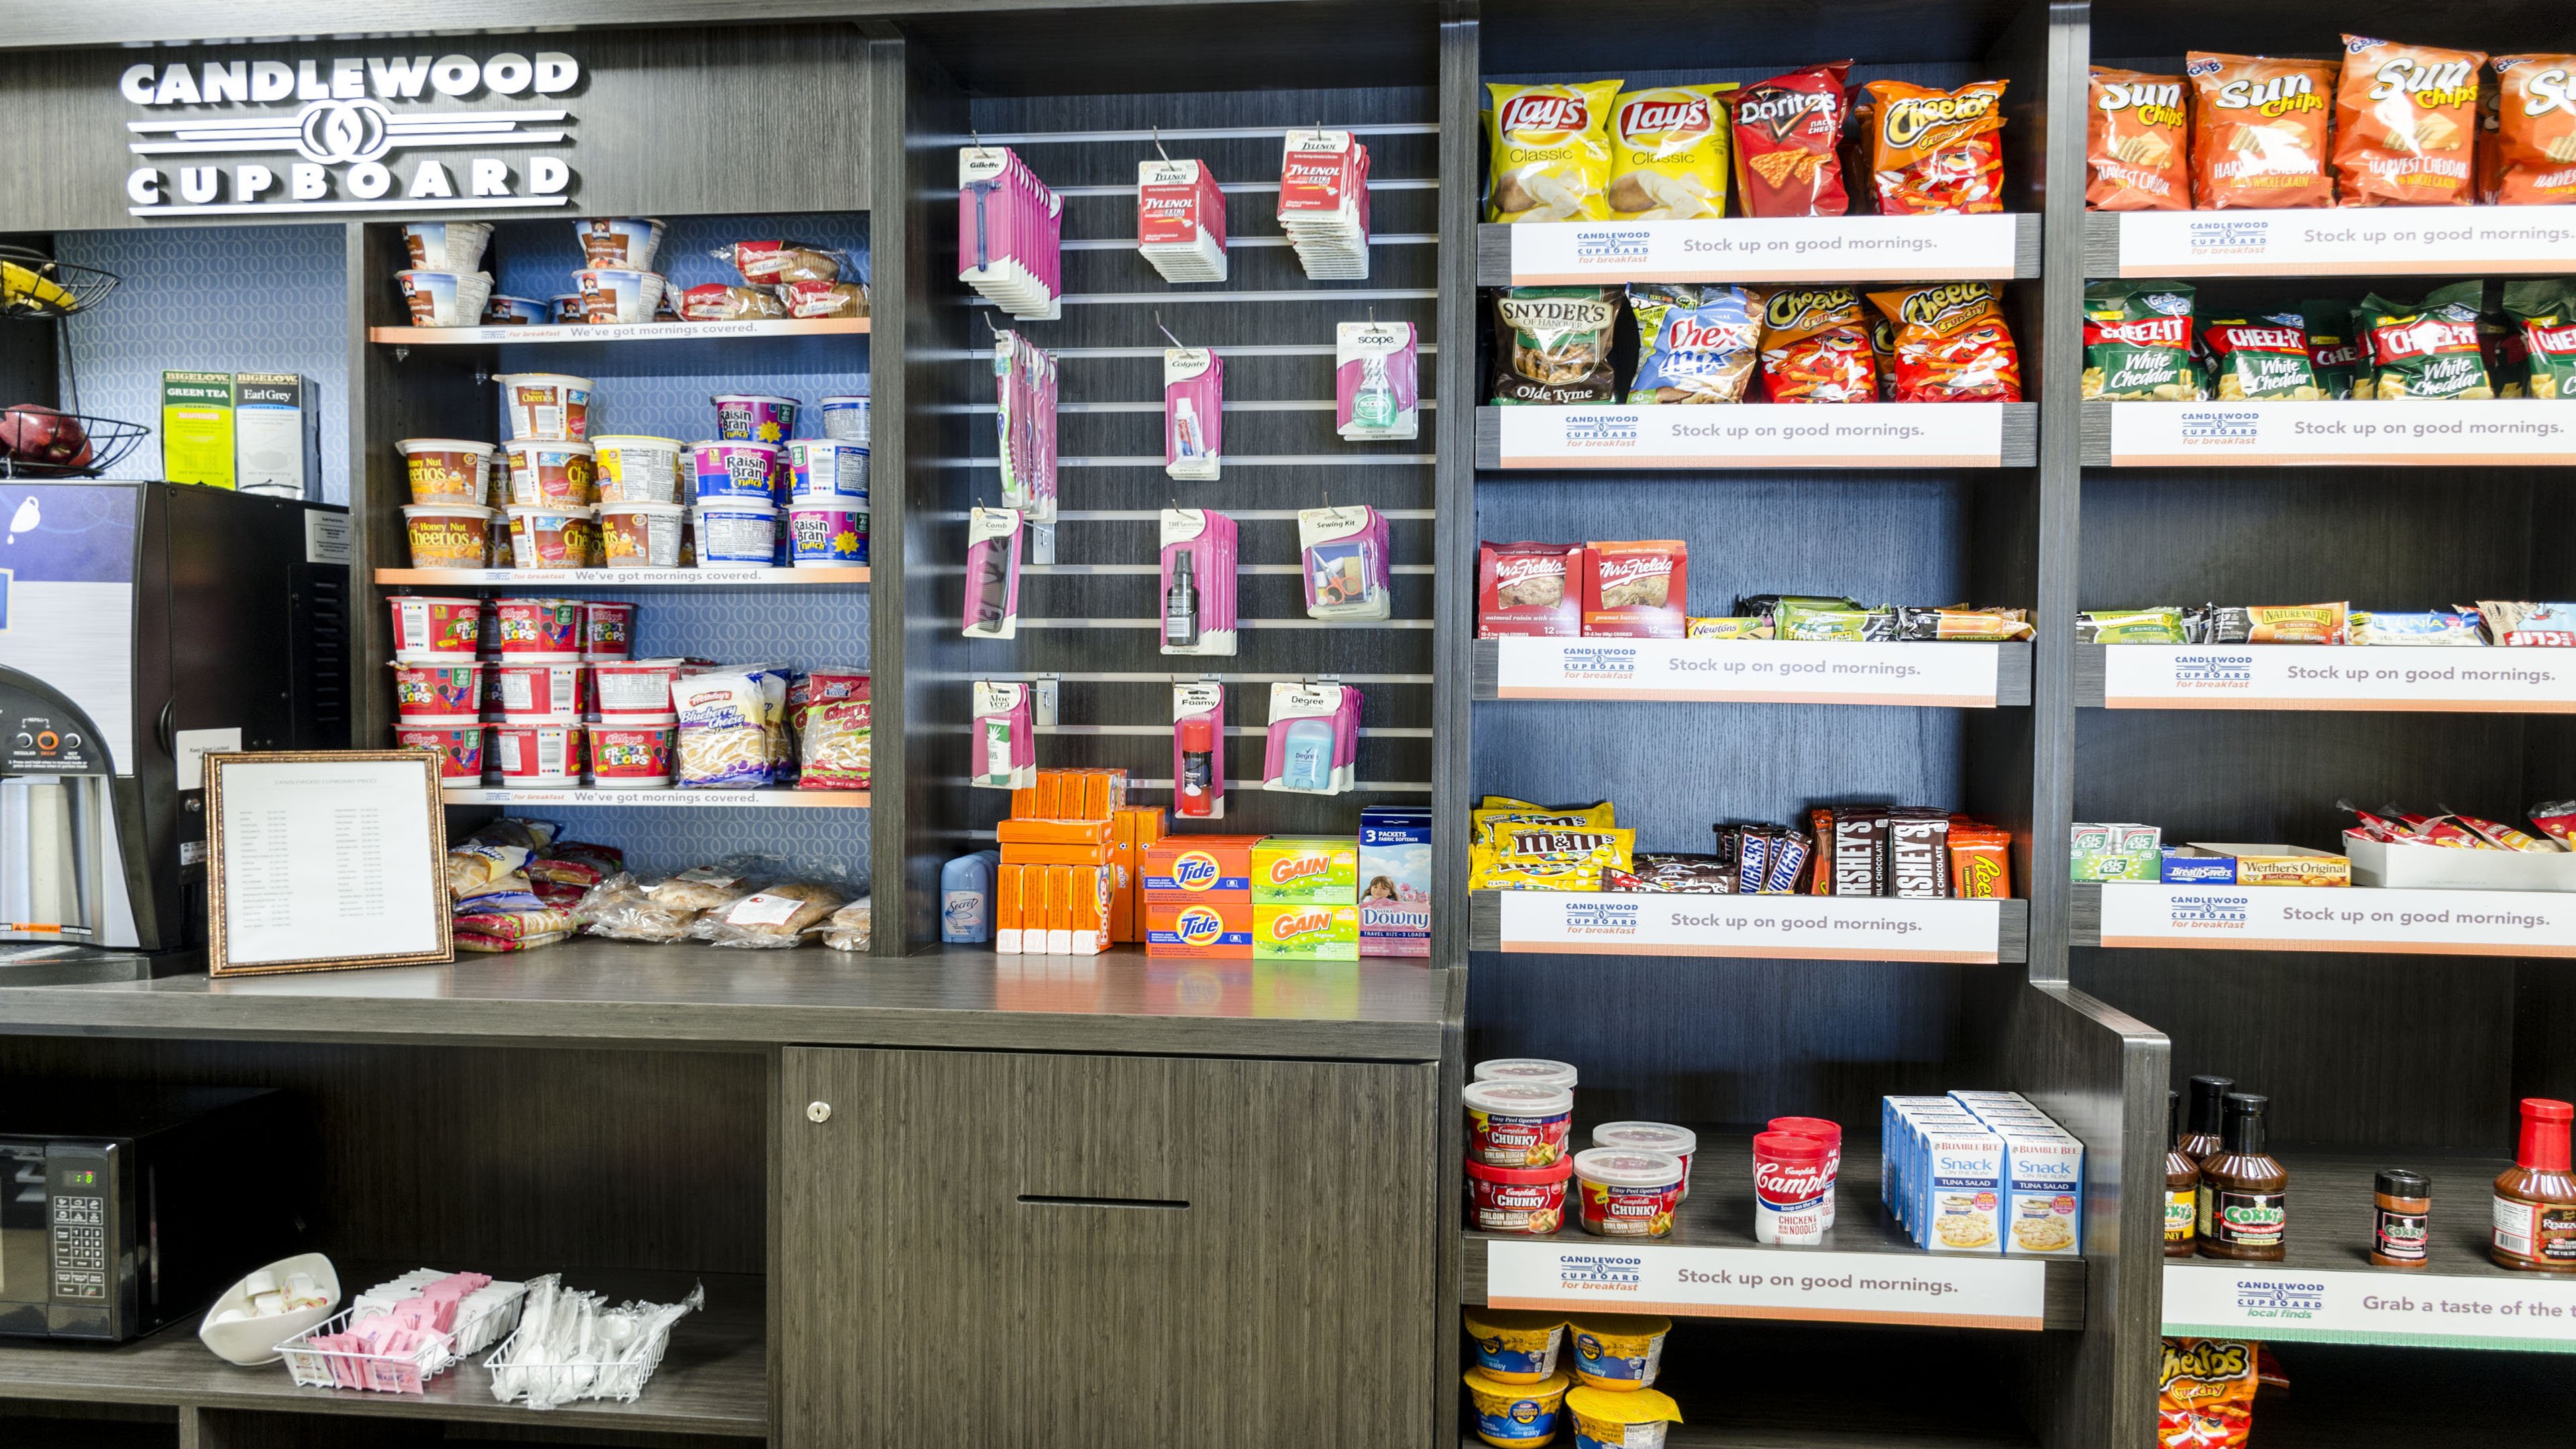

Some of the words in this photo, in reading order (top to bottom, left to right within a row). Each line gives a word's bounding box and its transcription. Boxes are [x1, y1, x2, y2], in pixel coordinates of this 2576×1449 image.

[121, 52, 580, 105] CANDLEWOOD
[2098, 83, 2181, 111] Sun
[2214, 73, 2312, 109] Sun
[1741, 91, 1836, 123] Doritos
[2259, 93, 2323, 117] Chips
[1505, 95, 1585, 131] Lay's
[1626, 99, 1707, 135] Lay's
[1885, 92, 1998, 148] Cheetos
[2138, 104, 2184, 129] Chips
[1919, 124, 1964, 150] Crunchy
[1509, 148, 1573, 162] Classic
[1633, 150, 1695, 165] Classic
[2369, 158, 2420, 174] HARVEST
[2423, 156, 2467, 179] CHEDDAR
[127, 156, 570, 204] CUPBOARD
[1155, 173, 1187, 182] TYLENOL
[1145, 198, 1193, 210] TYLENOL
[2304, 228, 2356, 243] Stock
[2363, 231, 2387, 245] up
[2393, 231, 2416, 241] on
[2423, 226, 2473, 244] good
[2480, 226, 2575, 243] mornings.
[1684, 238, 1733, 252] Stock
[1739, 241, 1761, 254] up
[1767, 241, 1789, 251] on
[1795, 235, 1842, 254] good
[1848, 235, 1937, 252] mornings.
[1503, 303, 1605, 323] SNYDER'S
[1936, 303, 1986, 333] Crunchy
[570, 327, 609, 337] We've
[613, 327, 635, 338] got
[639, 325, 698, 336] mornings
[702, 323, 757, 333] covered.
[1523, 319, 1536, 327] OF
[1538, 319, 1583, 329] HANOVER
[2100, 319, 2184, 342] CHEEZ-IT
[1668, 315, 1742, 350] Chex
[2226, 327, 2302, 349] CHEEZ-IT
[1358, 335, 1394, 345] scope
[1172, 361, 1205, 369] Colgate
[2125, 352, 2171, 370] White
[2261, 358, 2300, 374] White
[166, 372, 229, 382] BIGELOW
[237, 373, 297, 382] BIGELOW
[2111, 369, 2177, 388] Cheddar
[2253, 372, 2309, 392] Cheddar
[167, 388, 205, 397] GREEN
[207, 389, 228, 398] TEA
[244, 389, 265, 399] Earl
[266, 390, 291, 402] Grey
[1517, 386, 1551, 401] Olde
[1554, 387, 1593, 402] Tyme
[727, 455, 767, 470] Raisin
[732, 469, 764, 479] Bran
[731, 478, 762, 488] Crunch
[421, 523, 446, 532] Honey
[449, 523, 466, 531] Nut
[1317, 521, 1342, 529] Sewing
[409, 529, 470, 547] Cheerios
[2265, 610, 2302, 621] NATURE
[2303, 609, 2329, 623] VALLEY
[2374, 617, 2445, 629] LUNA
[1694, 624, 1737, 635] Newtons
[2508, 632, 2557, 646] CLIF
[1669, 657, 1718, 671] Stock
[1723, 662, 1746, 675] up
[1752, 663, 1773, 672] on
[1779, 659, 1826, 676] good
[1832, 661, 1921, 678] mornings.
[989, 694, 1009, 703] Aloe
[1182, 699, 1216, 708] Foamy
[1291, 697, 1324, 706] Degree
[681, 705, 737, 723] Blueberry
[708, 715, 745, 729] Cheese
[606, 733, 644, 745] Kellogg's
[604, 745, 646, 757] FROOT
[610, 755, 649, 766] LOOPS
[1366, 829, 1376, 842] 3
[1837, 822, 1872, 895] RSHEY'S
[1177, 861, 1215, 883] Tide
[1271, 856, 1330, 884] GAIN
[2245, 861, 2298, 873] Werther's
[2301, 861, 2347, 875] Original
[948, 898, 979, 912] Secret
[1363, 909, 1429, 928] Downy
[2283, 907, 2334, 920] Stock
[2341, 912, 2365, 925] up
[2371, 912, 2394, 922] on
[2400, 909, 2449, 926] good
[2456, 912, 2550, 929] mornings.
[1491, 1132, 1538, 1146] CHUNKY
[1941, 1142, 1978, 1151] BUMBLE
[1982, 1143, 2000, 1151] BEE
[1940, 1157, 1992, 1171] Snack
[1497, 1195, 1545, 1208] CHUNKY
[1480, 1211, 1504, 1220] SIRLOIN
[1505, 1212, 1528, 1220] BURGER
[1778, 1216, 1813, 1224] CHICKEN
[1789, 1223, 1817, 1235] NOODLES
[1560, 1256, 1641, 1265] CANDLEWOOD
[1561, 1273, 1639, 1281] CUPBOARD
[1678, 1269, 1732, 1284] Stock
[1739, 1275, 1764, 1289] up
[1770, 1276, 1794, 1286] on
[1801, 1274, 1852, 1291] good
[1860, 1277, 1958, 1296] mornings.
[1582, 1282, 1638, 1291] breakfast
[2237, 1281, 2324, 1291] CANDLEWOOD
[2238, 1299, 2322, 1308] CUPBOARD
[2363, 1295, 2415, 1311] Grab
[2422, 1301, 2433, 1312] a
[2440, 1300, 2493, 1314] taste
[2500, 1300, 2522, 1316] of
[2528, 1301, 2563, 1317] the
[2247, 1309, 2277, 1318] local
[2280, 1309, 2312, 1319] finds
[1523, 1429, 1540, 1437] easy
